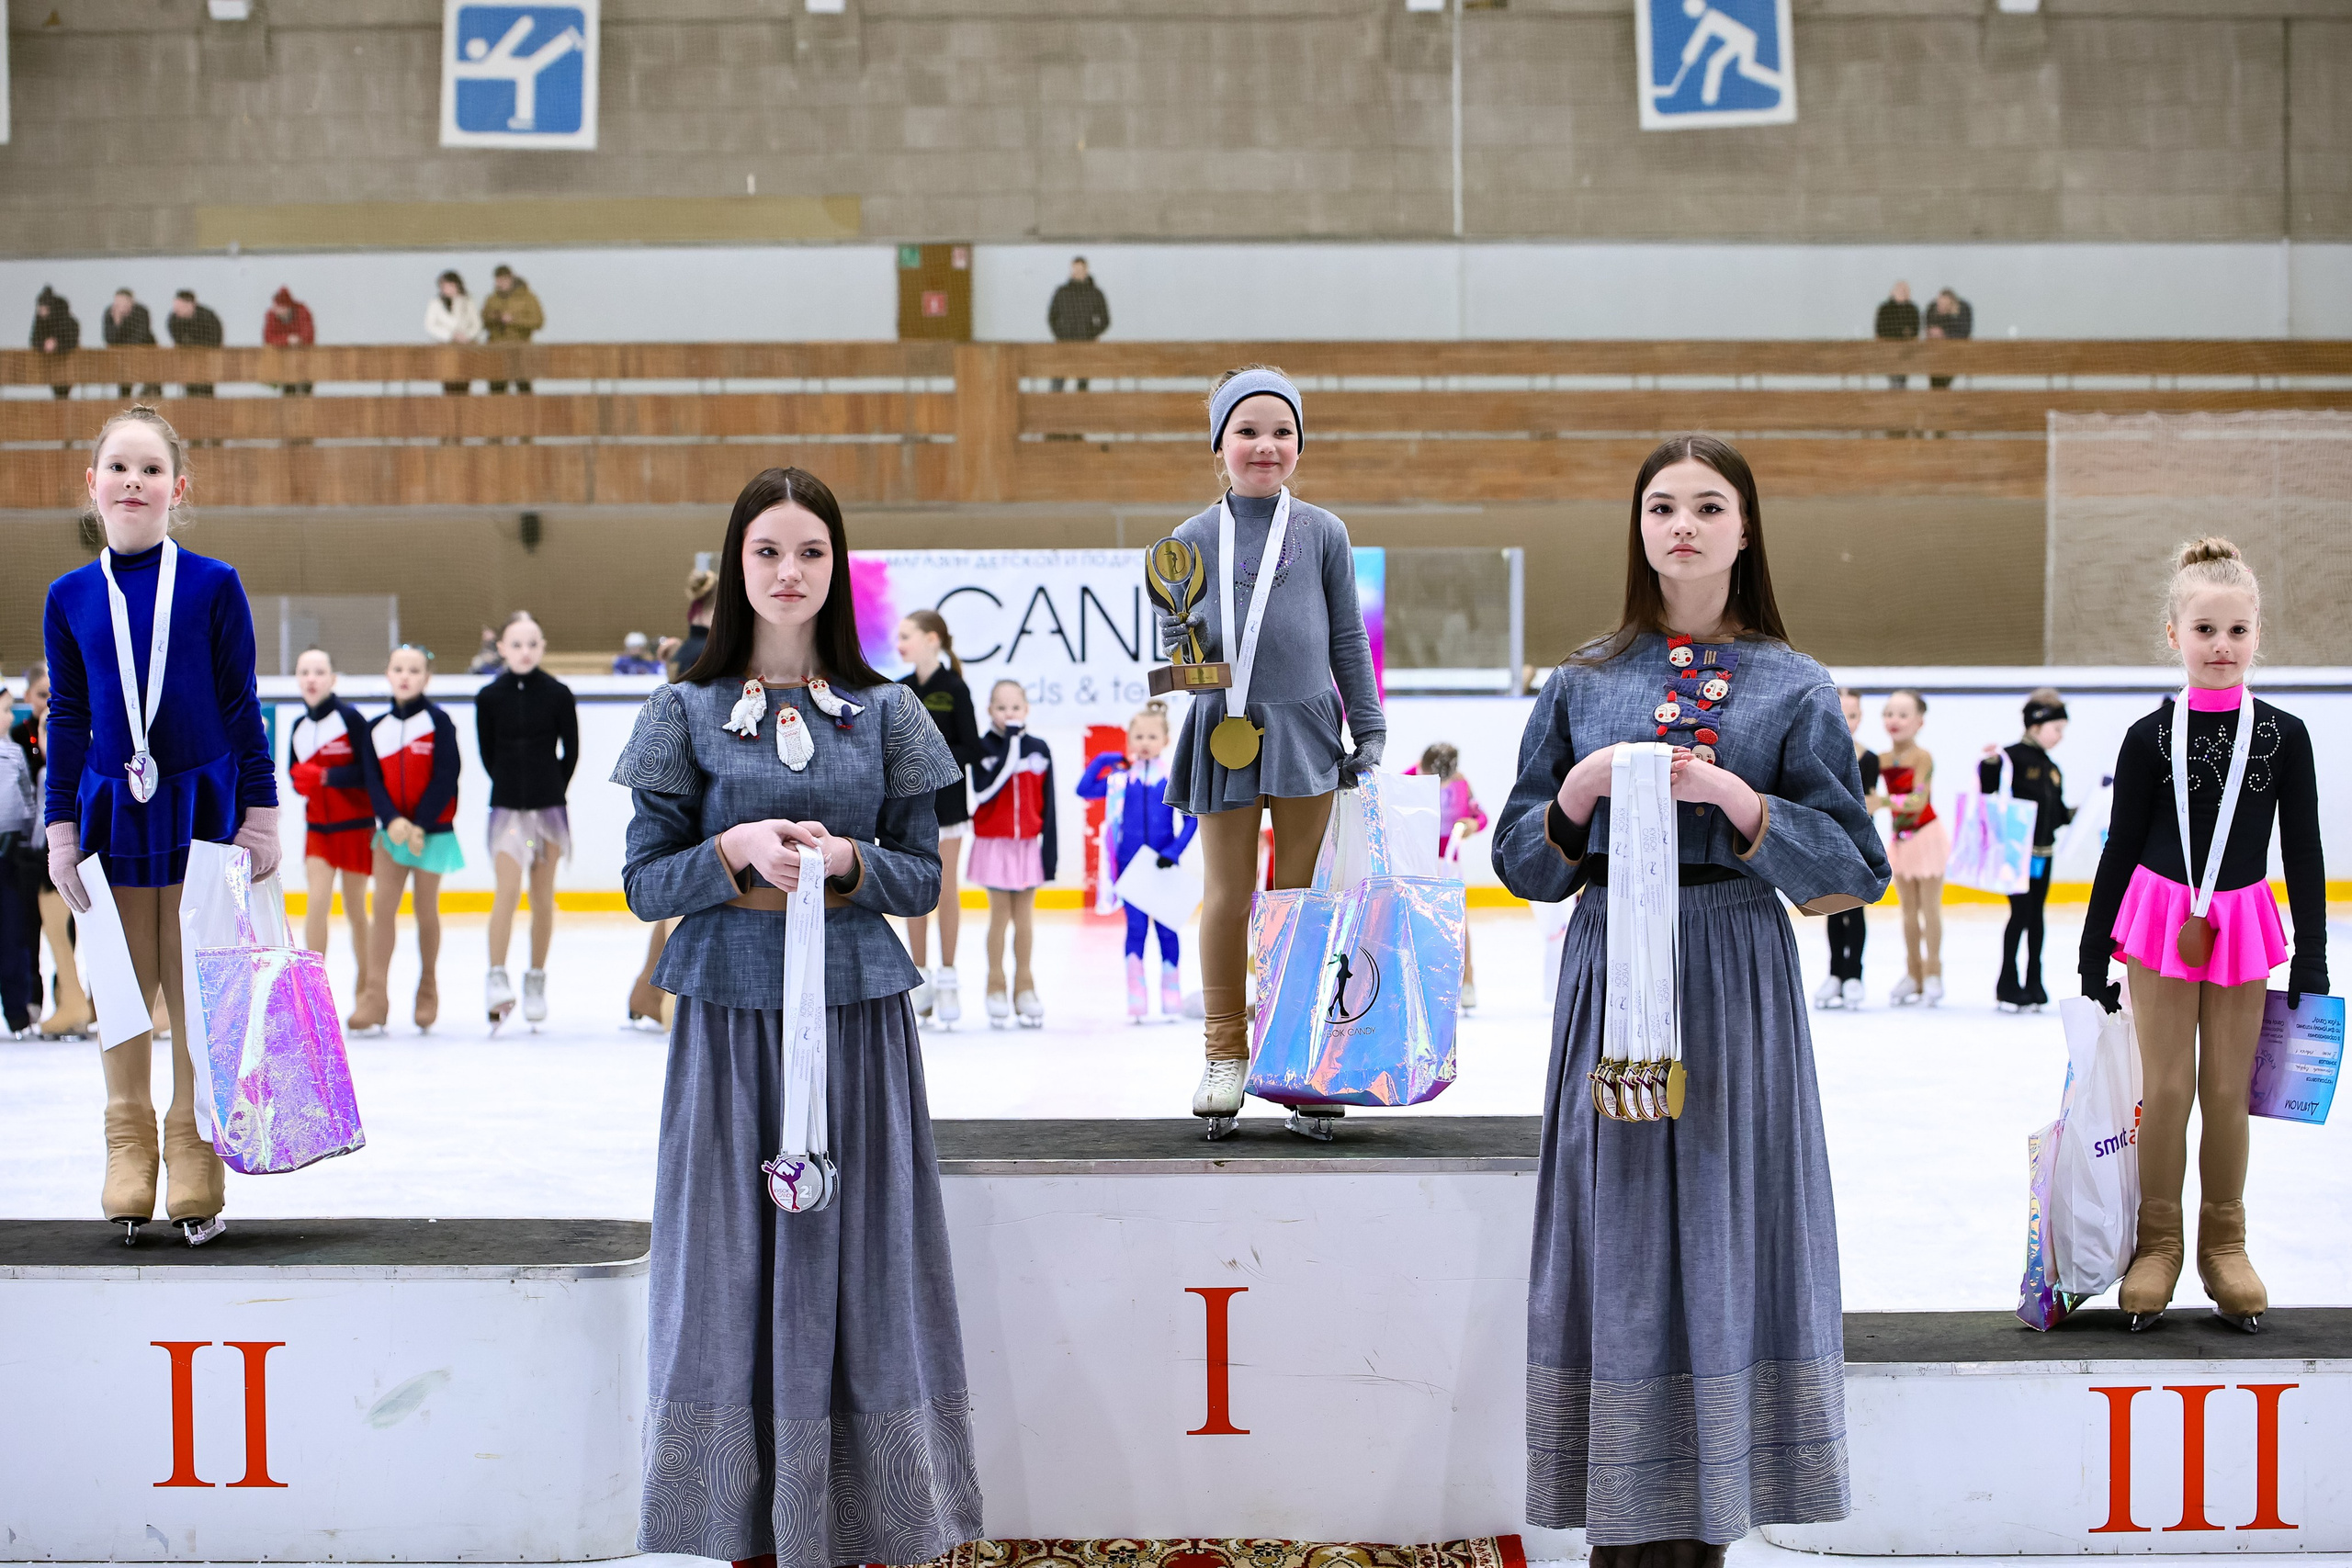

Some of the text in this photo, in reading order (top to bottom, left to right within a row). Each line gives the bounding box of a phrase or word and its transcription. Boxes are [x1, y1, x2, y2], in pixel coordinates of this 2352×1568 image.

[1347, 1026, 1376, 1036] CANDY
[799, 1186, 809, 1198] 2
[152, 1342, 287, 1486] II
[1185, 1288, 1249, 1434] I
[2089, 1383, 2298, 1531] III
